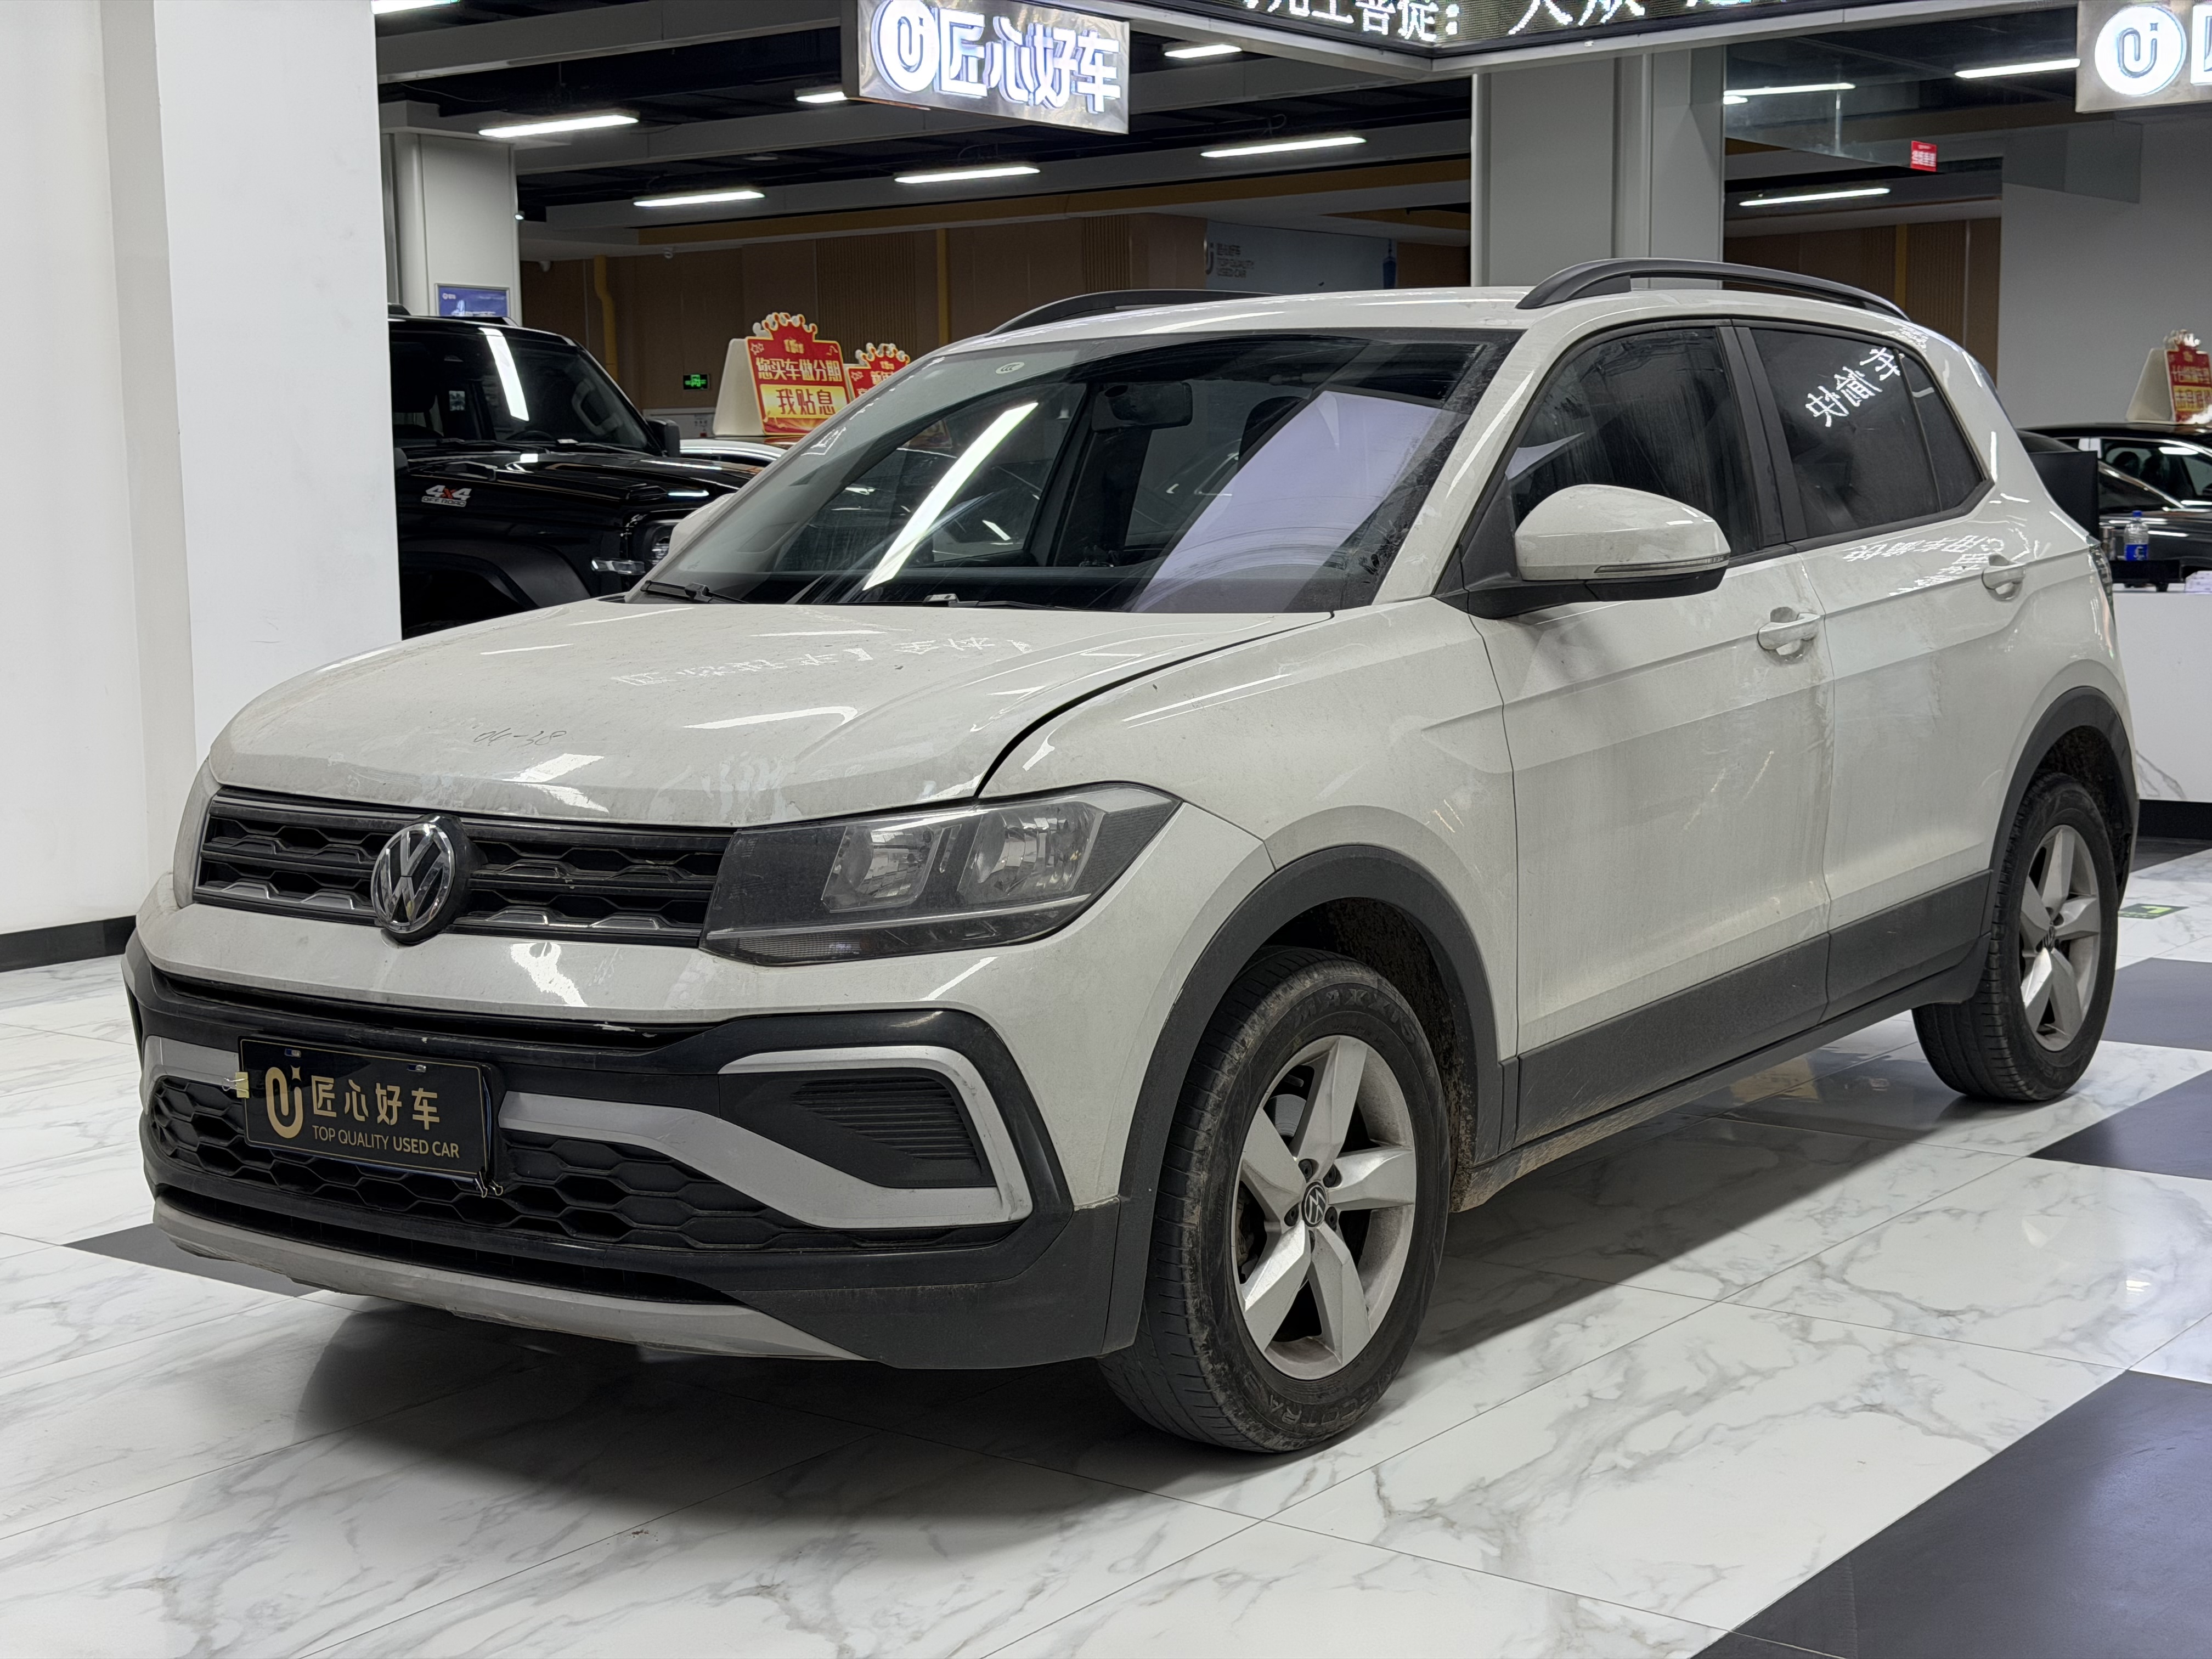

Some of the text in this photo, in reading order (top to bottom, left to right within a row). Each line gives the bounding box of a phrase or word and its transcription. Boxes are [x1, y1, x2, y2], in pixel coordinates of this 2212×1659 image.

[934, 8, 1121, 113] 匠心好车
[755, 357, 843, 382] 您买车做分期
[775, 388, 837, 416] 我贴息
[311, 1075, 441, 1131] 匠心好车
[312, 1125, 460, 1159] TOP QUALITY USED CAR
